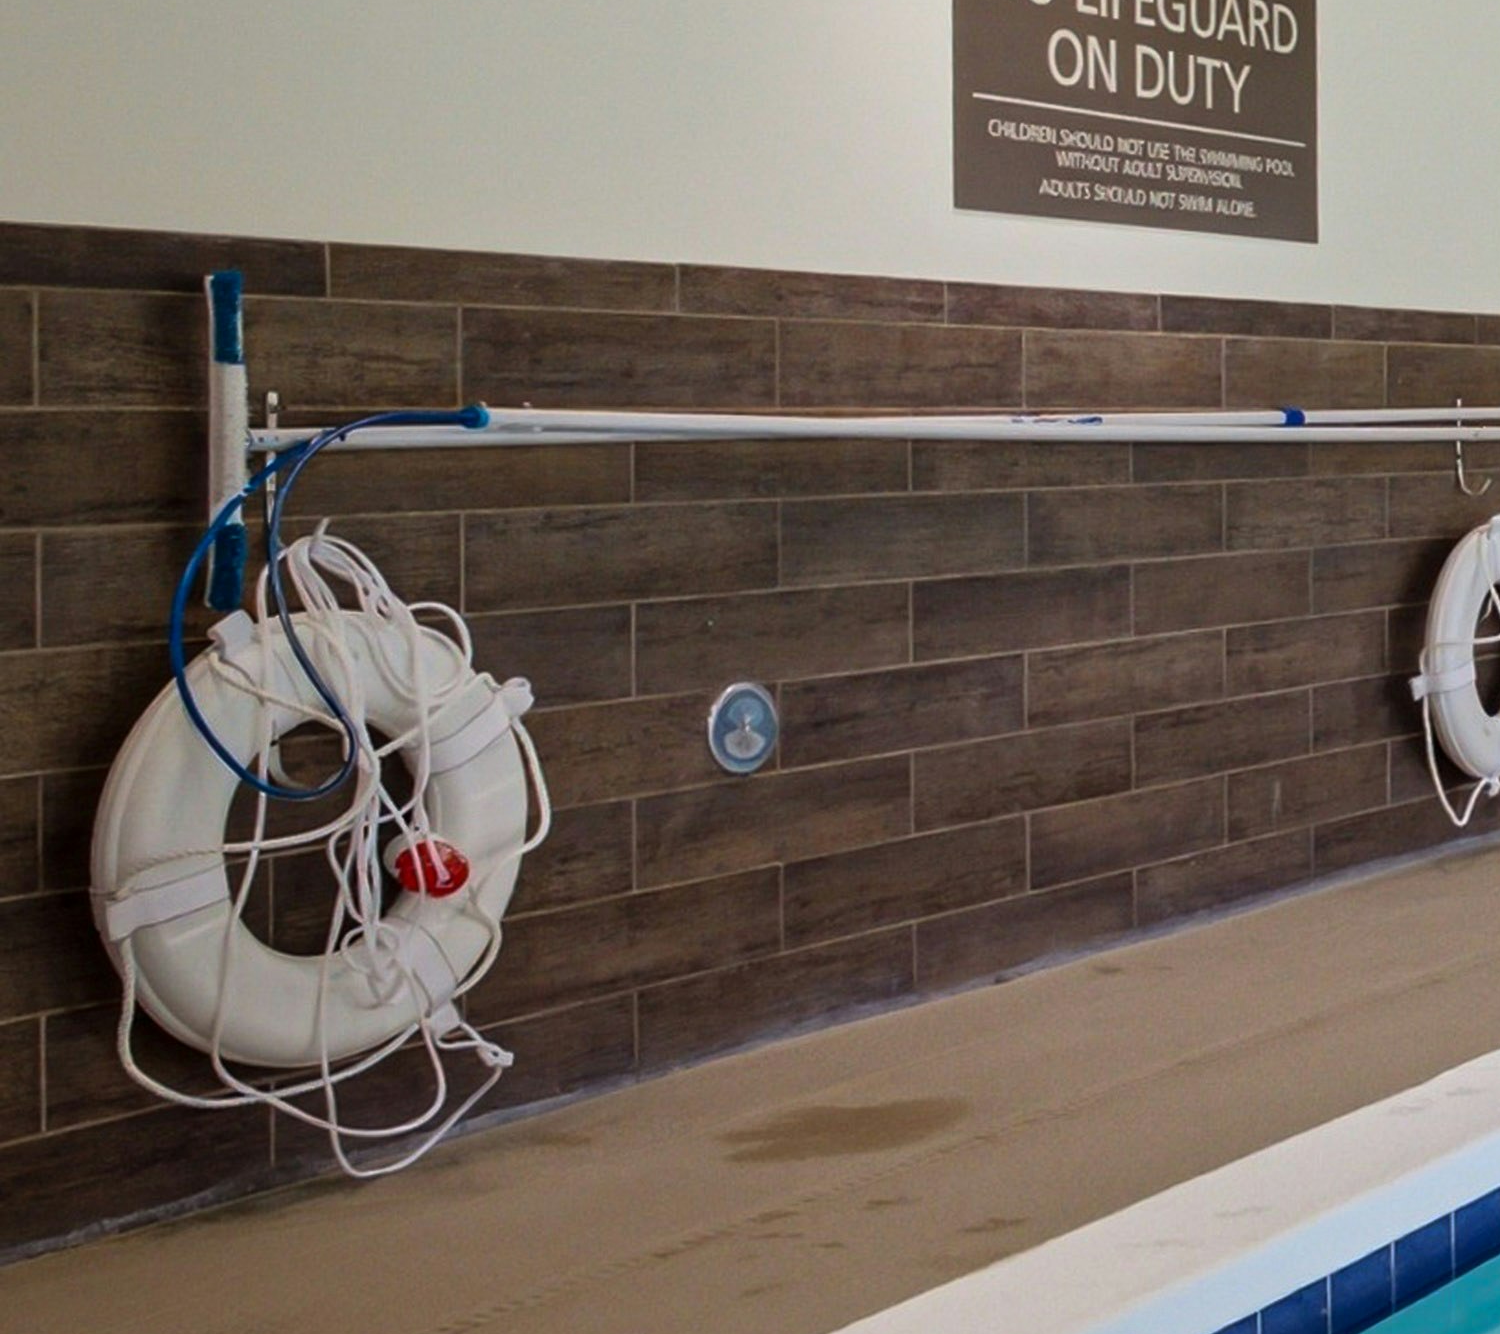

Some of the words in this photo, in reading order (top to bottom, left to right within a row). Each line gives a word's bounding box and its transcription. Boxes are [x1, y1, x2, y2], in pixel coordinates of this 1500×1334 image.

[1047, 29, 1117, 94] ON
[1136, 44, 1251, 114] DUTY
[988, 118, 1057, 144] CHILDREN
[1059, 128, 1114, 152] SHOULD
[1117, 136, 1144, 156] NOT
[1147, 142, 1170, 160] USE
[1173, 145, 1196, 164] THE
[1199, 148, 1263, 173] SWIMMING
[1056, 150, 1120, 173] WITHOUT
[1123, 159, 1162, 179] ADULT
[1039, 178, 1091, 200] ADULTS
[1094, 183, 1147, 207] SHOULD
[1150, 190, 1176, 210] NOT
[1178, 194, 1213, 213] SWIM
